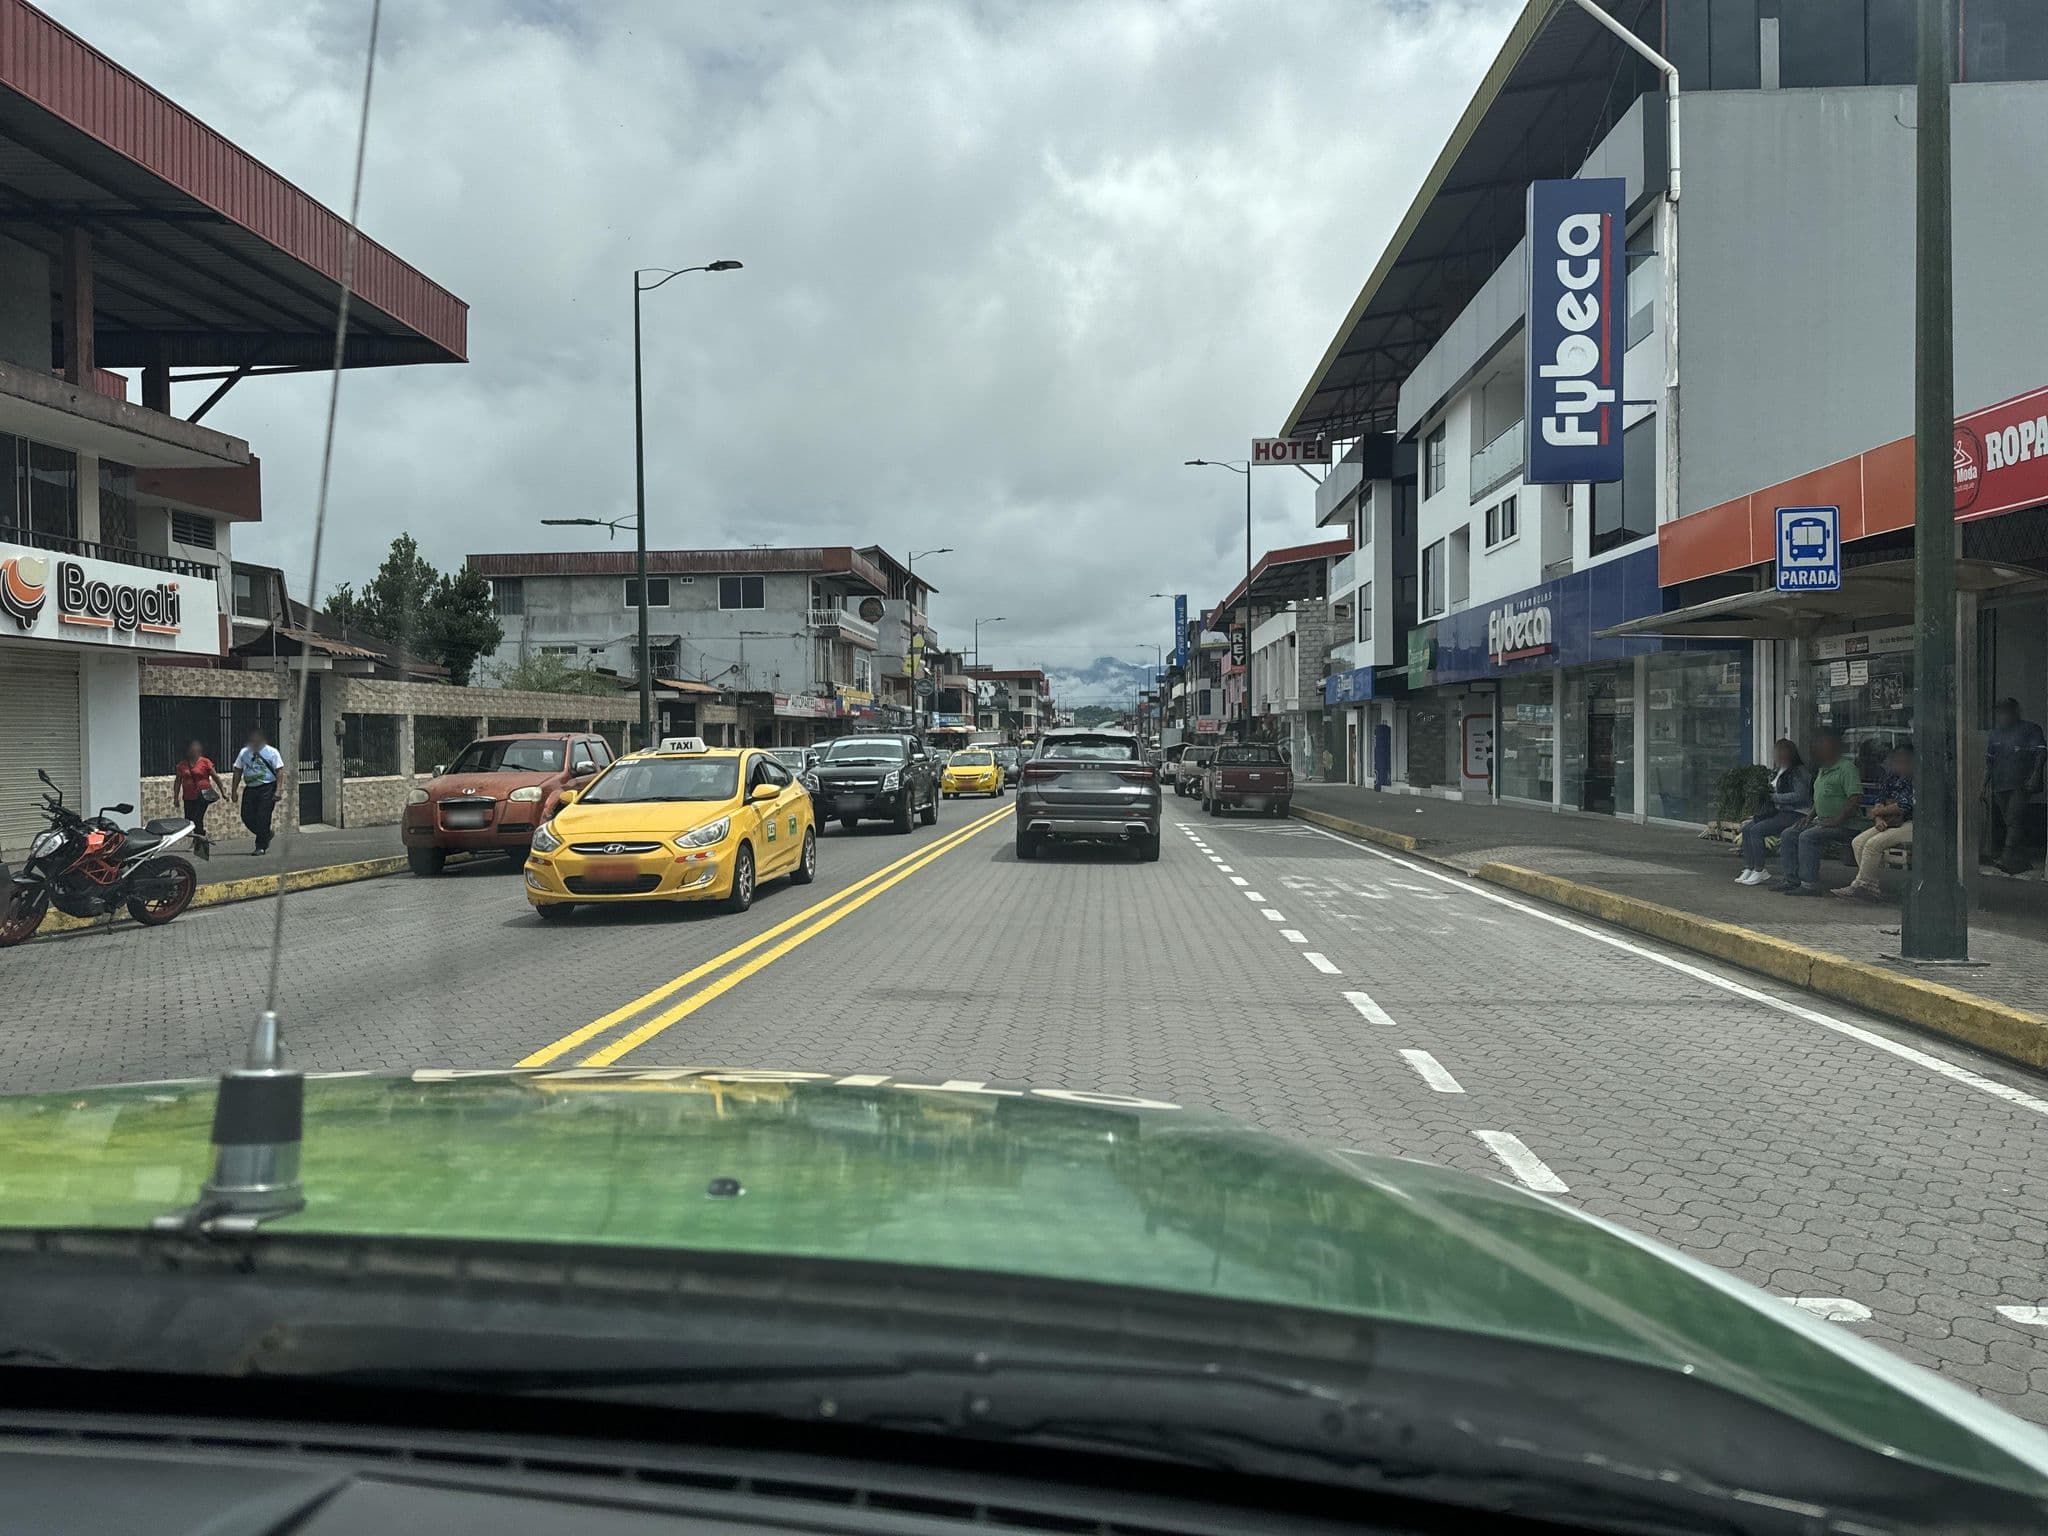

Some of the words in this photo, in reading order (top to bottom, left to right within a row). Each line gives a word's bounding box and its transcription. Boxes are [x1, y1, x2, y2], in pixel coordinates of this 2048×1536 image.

[1539, 212, 1615, 446] fybeca
[1255, 440, 1329, 461] HOTEL
[1985, 415, 2048, 471] ROPA
[1956, 465, 1978, 483] Moda
[1780, 569, 1837, 586] PARADA
[57, 561, 181, 632] Bogati
[1232, 632, 1244, 665] REY
[1489, 603, 1552, 666] fybeca
[669, 741, 693, 751] TAXI
